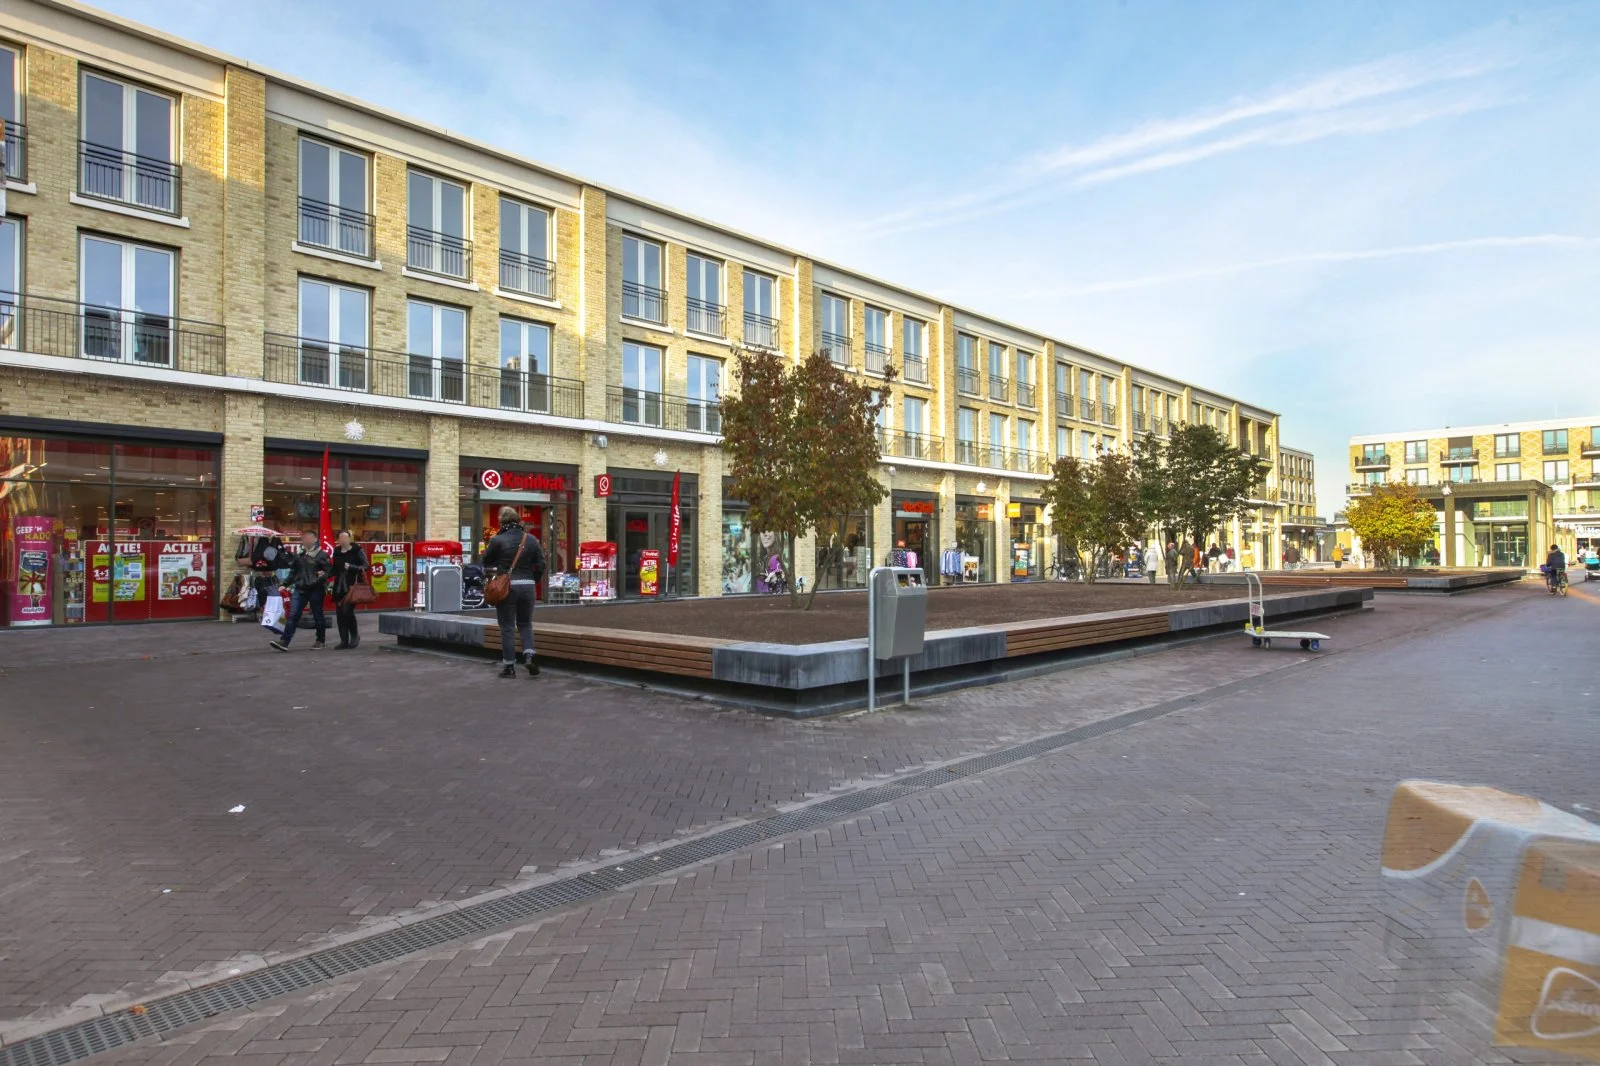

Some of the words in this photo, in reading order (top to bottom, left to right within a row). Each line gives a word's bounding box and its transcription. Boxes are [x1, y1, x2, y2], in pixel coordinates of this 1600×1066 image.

[503, 471, 564, 490] Kruidvat
[16, 526, 33, 535] GEEF
[163, 543, 202, 552] ACTIE!
[374, 543, 404, 554] ACTIE!
